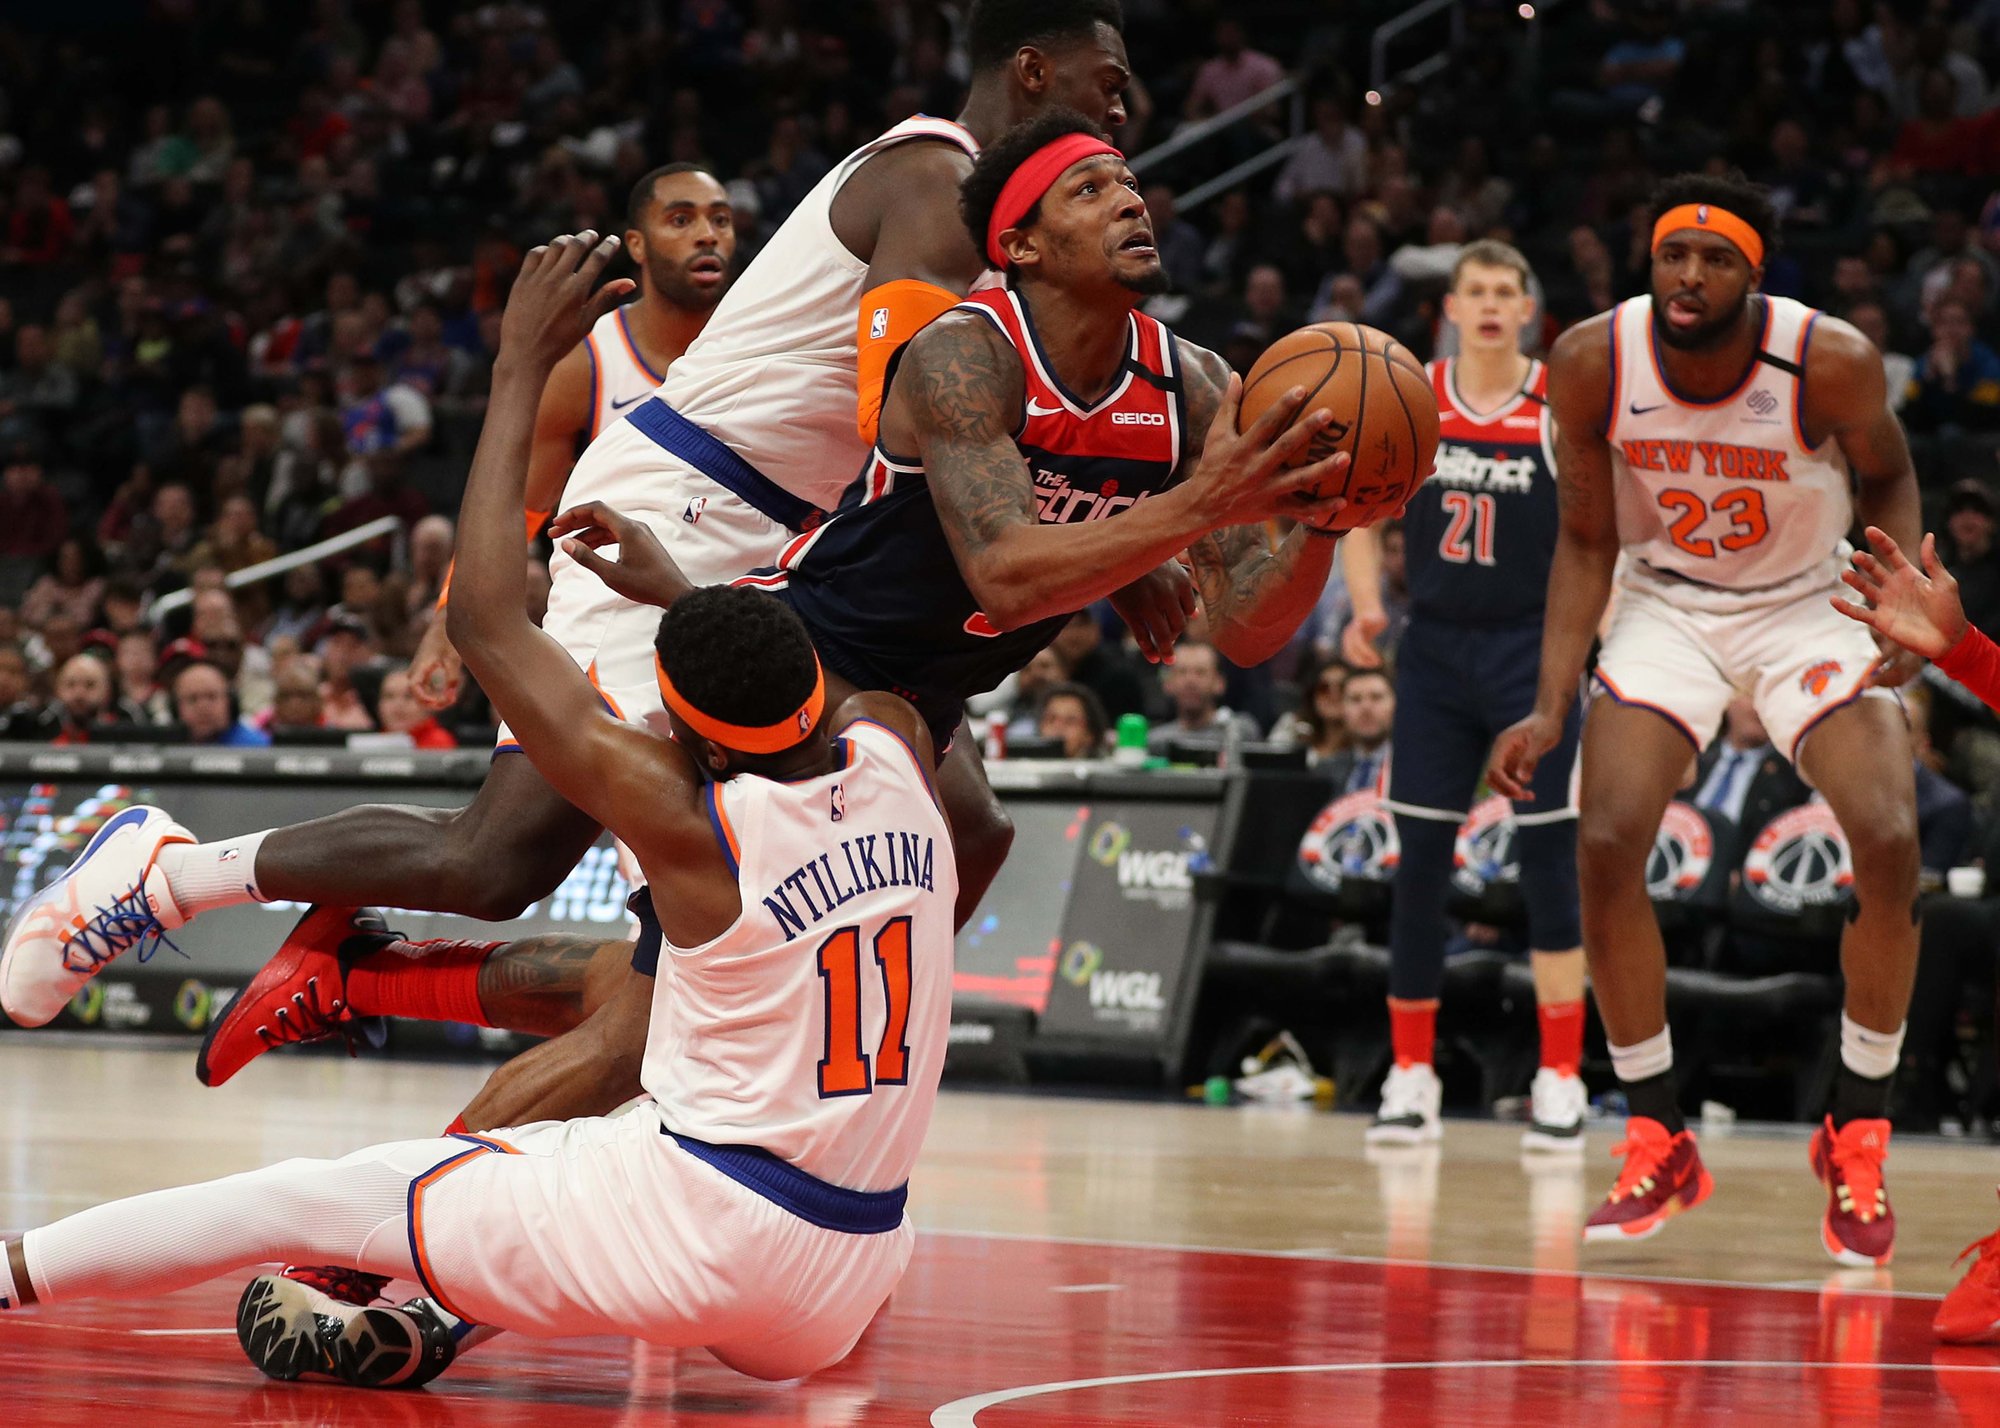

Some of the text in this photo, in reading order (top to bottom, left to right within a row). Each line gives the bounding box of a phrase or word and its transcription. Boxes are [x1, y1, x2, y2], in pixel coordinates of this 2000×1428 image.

[1111, 412, 1165, 426] GEICO
[1035, 468, 1067, 487] THE
[1621, 439, 1791, 482] NEW YORK
[1438, 490, 1497, 567] 21
[1657, 486, 1769, 558] 23
[762, 831, 934, 942] NTILIKINA
[1117, 851, 1194, 889] WGL
[816, 915, 912, 1099] 11
[1089, 970, 1166, 1010] WGL
